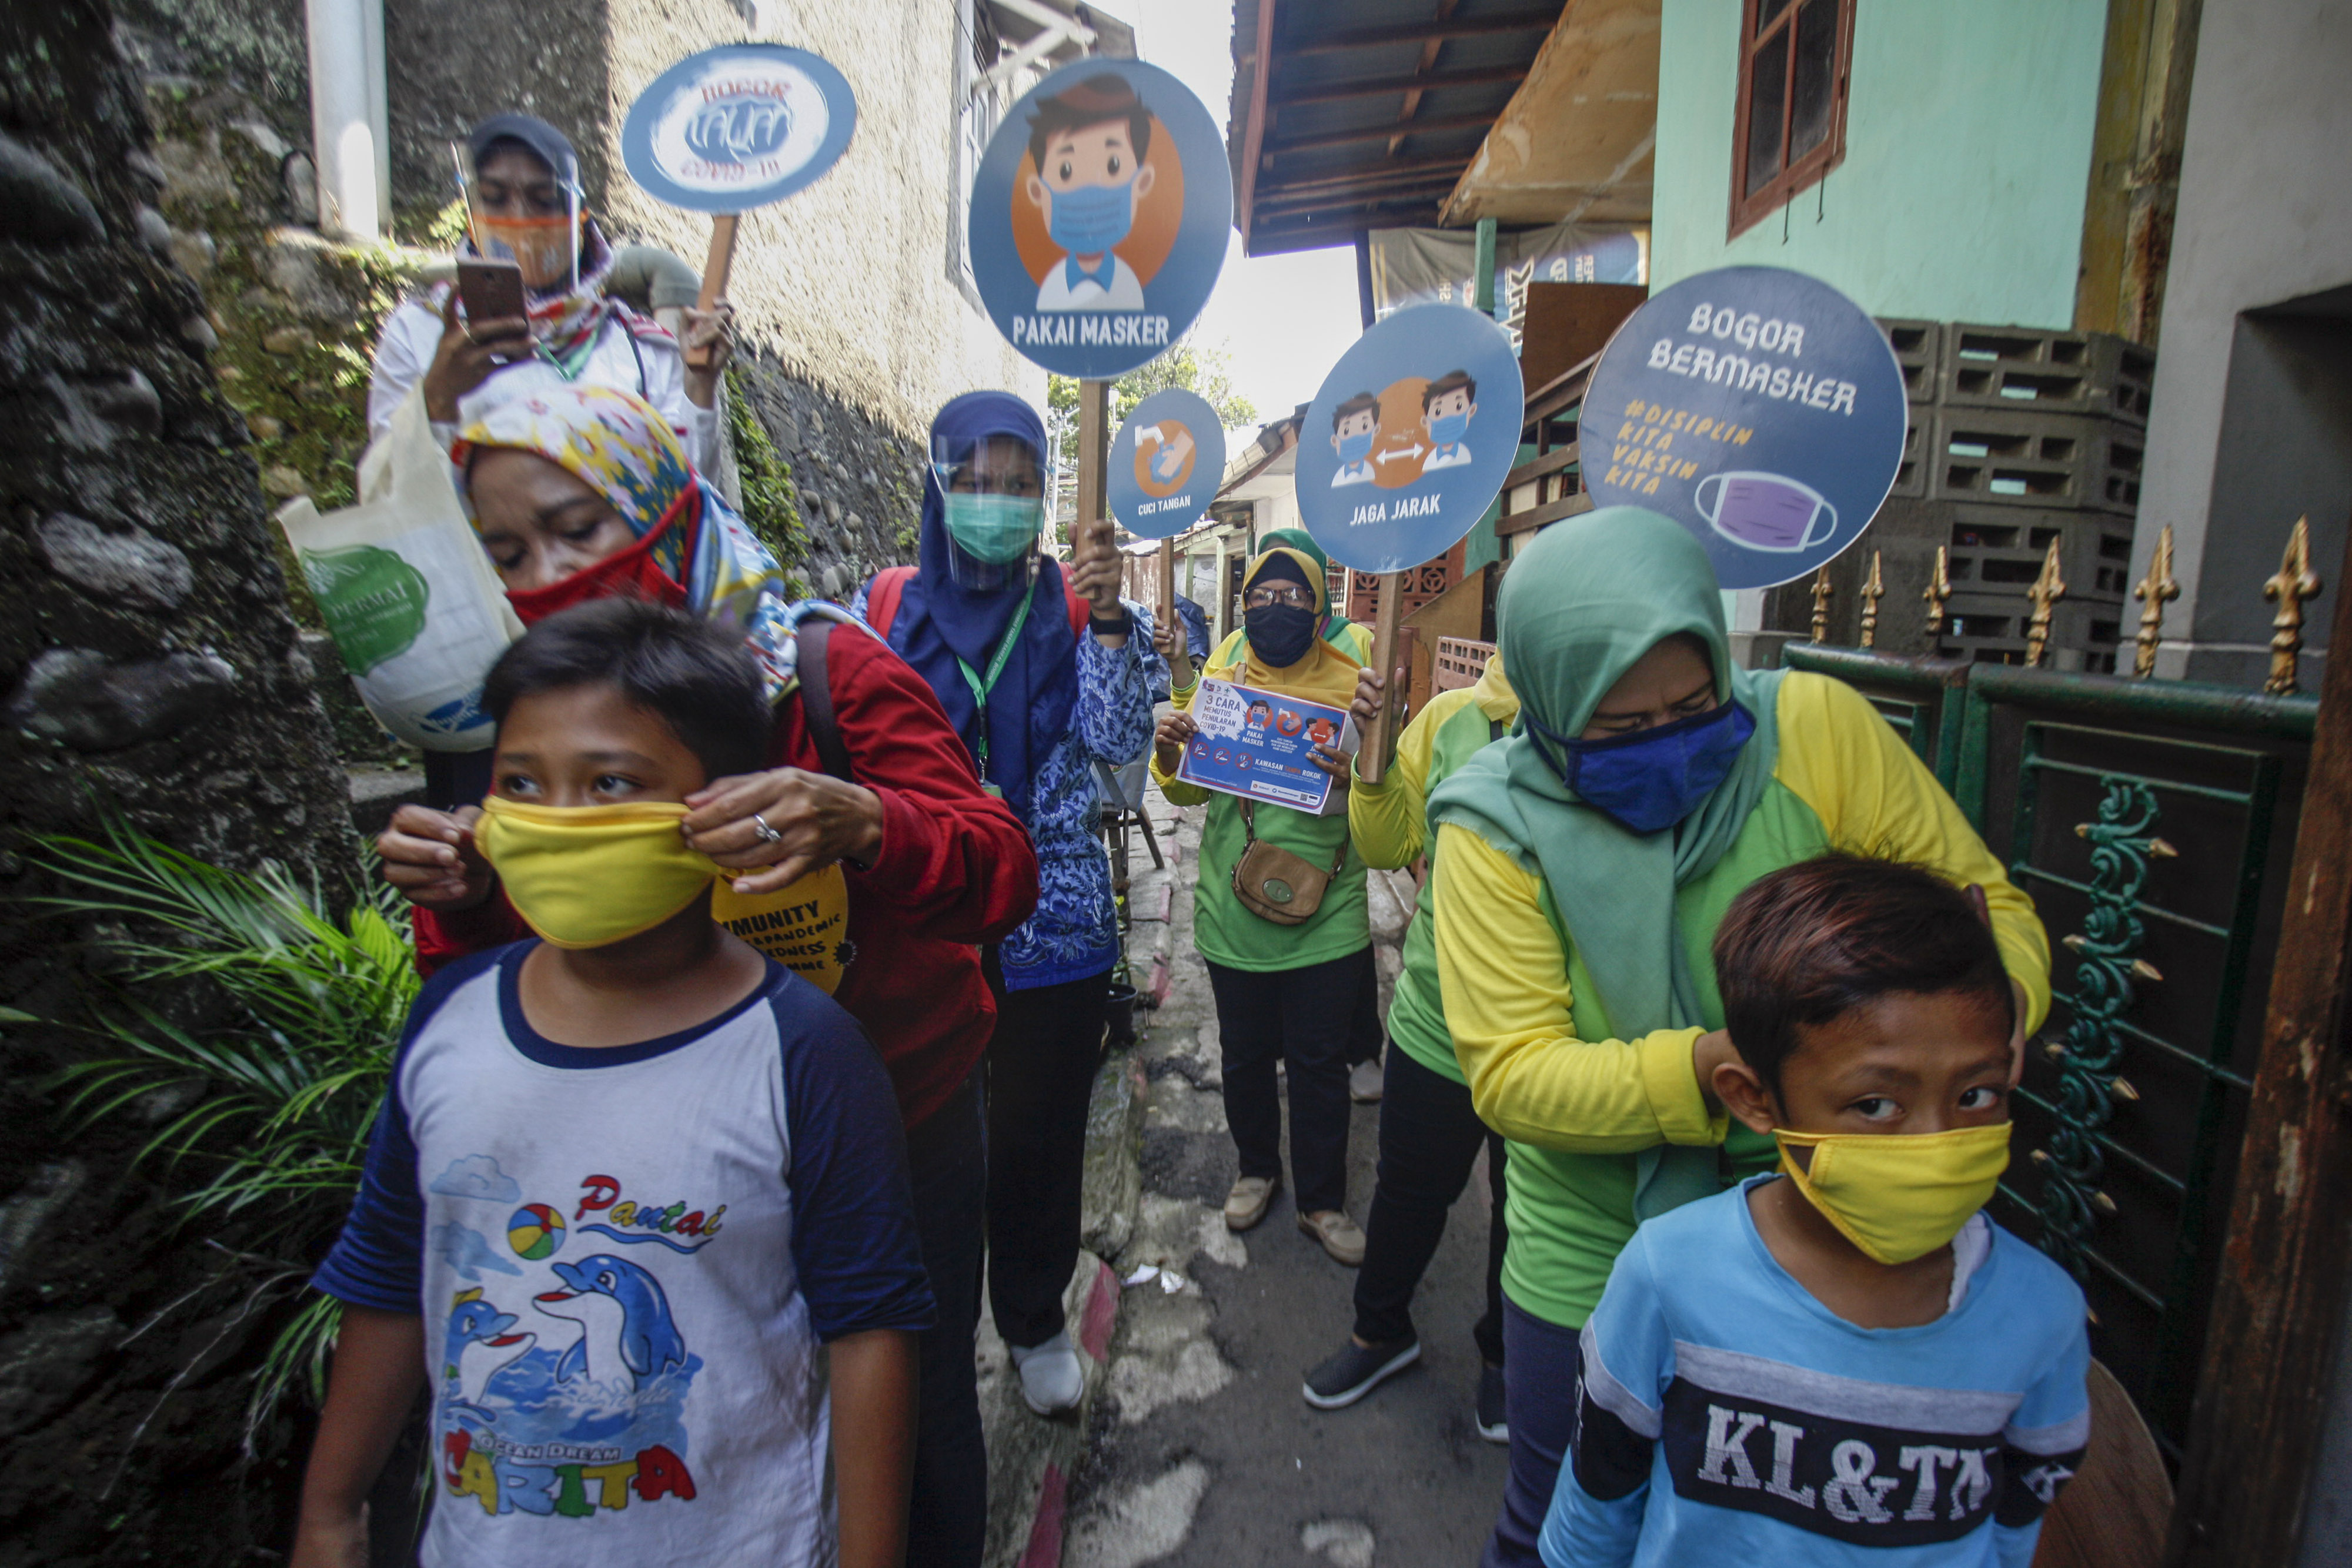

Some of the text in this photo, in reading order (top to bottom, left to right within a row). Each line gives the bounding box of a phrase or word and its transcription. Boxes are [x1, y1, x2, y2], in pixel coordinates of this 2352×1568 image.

[1013, 316, 1170, 346] PAKAI MASKER
[1686, 302, 1805, 359] BOGOR
[1647, 338, 1857, 417] BERMASHER
[1617, 420, 1673, 452] KITA
[1625, 399, 1753, 447] #DISIPLIN
[1612, 443, 1699, 480] VAKSIN
[1604, 465, 1661, 495] KITA
[1138, 495, 1191, 516] CUCI TANGAN
[1349, 493, 1441, 527] JAGA JARAK
[1204, 706, 1232, 717] MEMUTUS
[1206, 695, 1241, 711] 3 CARA
[1200, 721, 1226, 732] COVID-19
[1201, 713, 1237, 727] PENULARAN
[1247, 730, 1263, 739] PAKAI
[1242, 737, 1264, 747] MASKER
[1255, 758, 1284, 771] KAWASAN
[1302, 770, 1321, 780] ROKOK
[574, 1174, 727, 1236] Pantai
